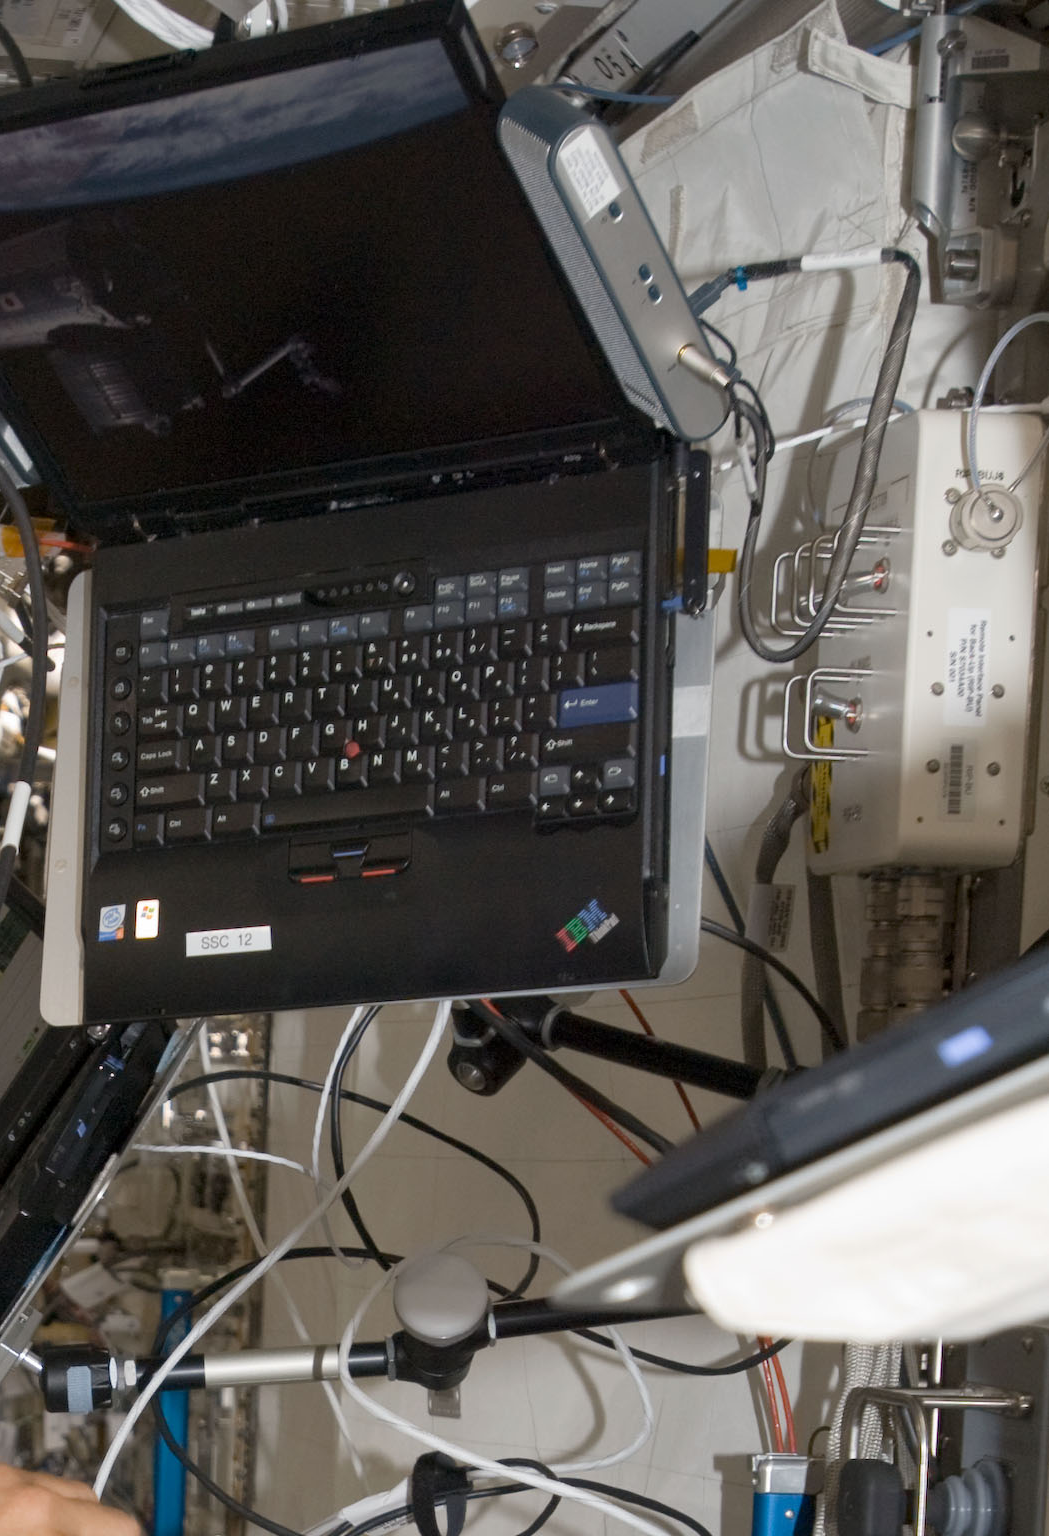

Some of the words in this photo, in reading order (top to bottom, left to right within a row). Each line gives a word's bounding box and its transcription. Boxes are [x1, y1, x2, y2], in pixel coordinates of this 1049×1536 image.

[547, 564, 565, 574] Insert
[579, 561, 598, 569] Home
[578, 586, 592, 595] End
[451, 671, 461, 682] O
[485, 666, 495, 678] P
[384, 679, 392, 691] U
[417, 674, 422, 687] I
[318, 688, 326, 699] T
[351, 683, 360, 695] Y
[252, 696, 260, 707] E
[284, 692, 293, 704] R
[580, 698, 599, 707] Enter
[188, 704, 198, 715] Q
[220, 700, 232, 711] W
[424, 711, 433, 722] K
[458, 707, 467, 719] L
[358, 719, 367, 731] H
[391, 715, 399, 727] J
[292, 727, 300, 739] F
[325, 723, 335, 735] G
[227, 735, 235, 747] S
[259, 731, 268, 743] D
[195, 739, 204, 751] A
[140, 752, 157, 760] Caps
[158, 750, 172, 758] Lock
[373, 754, 382, 766] N
[406, 750, 417, 761] M
[308, 762, 316, 774] V
[340, 758, 349, 770] B
[242, 769, 250, 781] X
[274, 766, 283, 777] C
[210, 773, 218, 784] Z
[150, 786, 164, 794] Shift
[439, 790, 450, 799] Alt
[491, 785, 505, 793] Ctrl
[169, 819, 181, 828] Ctrl
[217, 815, 227, 823] Alt
[555, 898, 607, 953] IBM
[201, 936, 229, 949] SSC
[238, 933, 252, 946] 12
